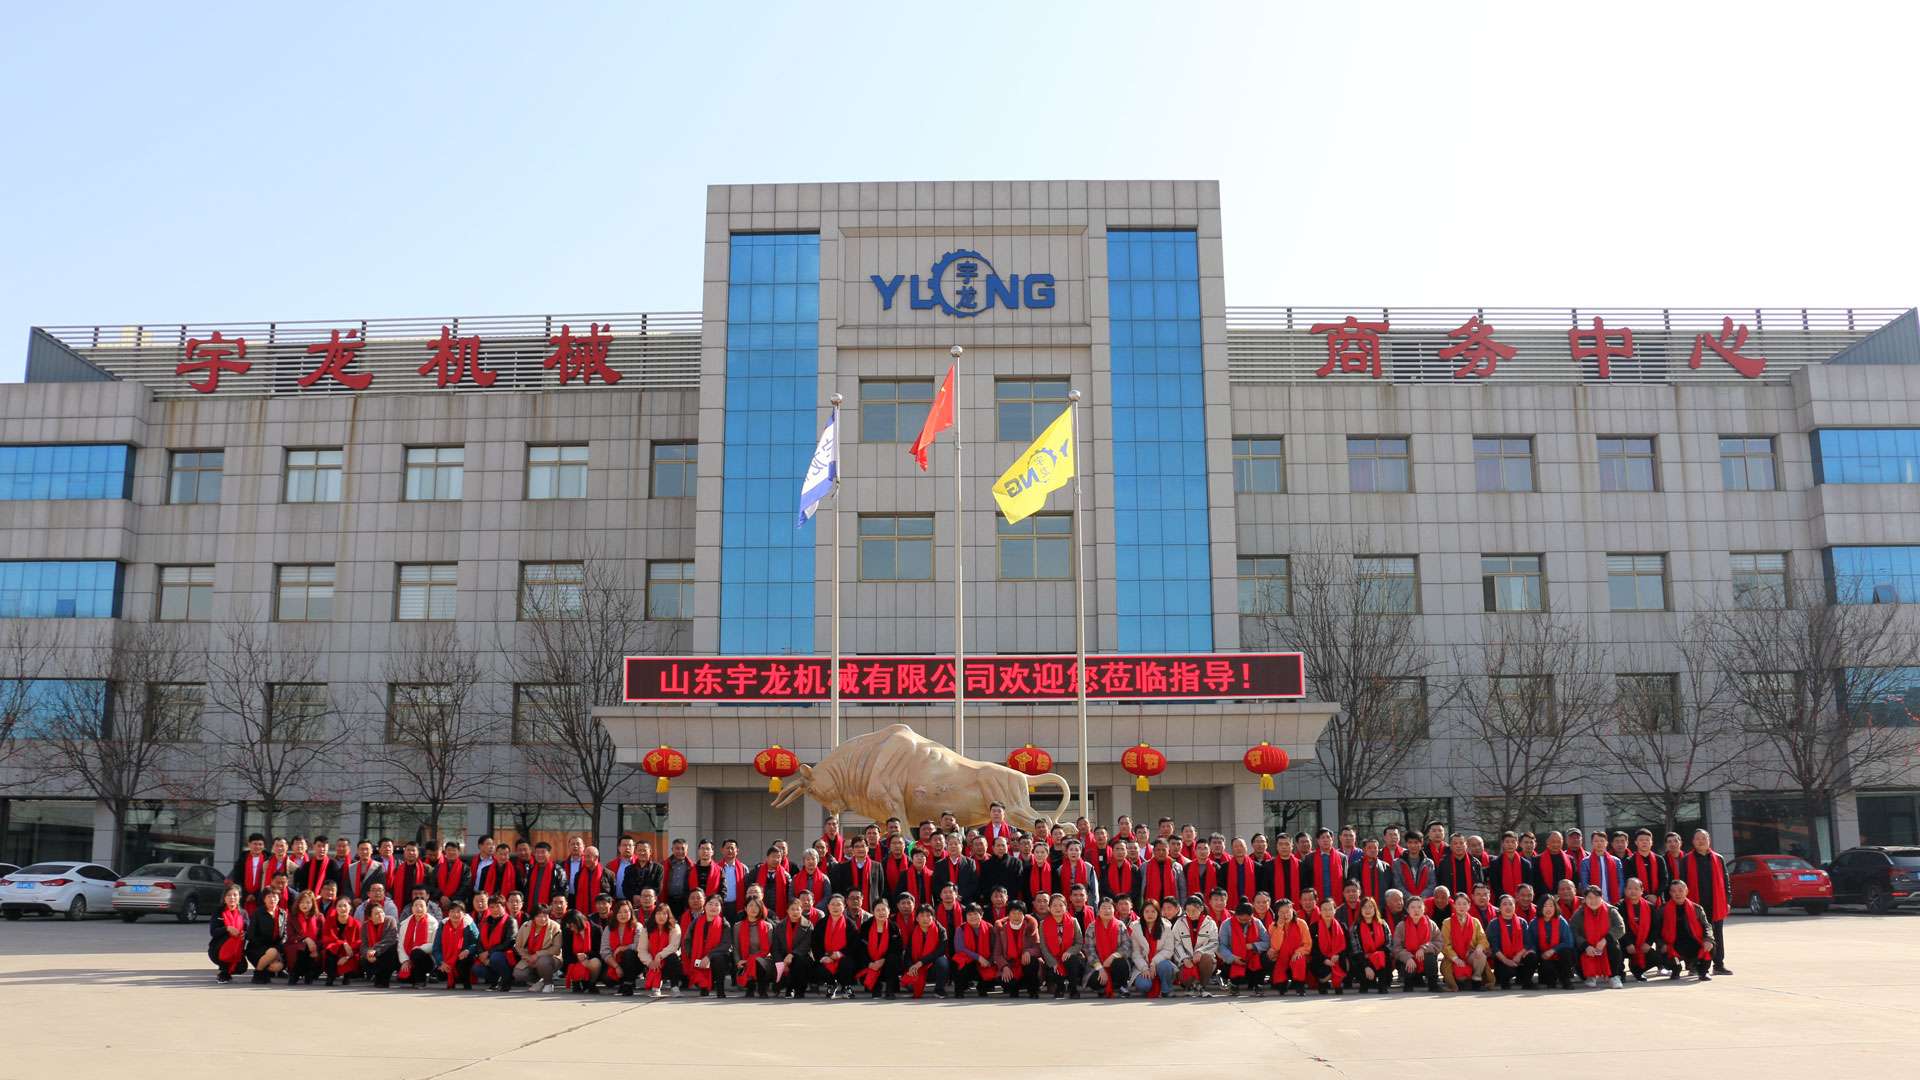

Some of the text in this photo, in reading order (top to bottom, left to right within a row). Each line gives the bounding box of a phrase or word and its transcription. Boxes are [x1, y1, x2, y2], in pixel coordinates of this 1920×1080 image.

[176, 323, 622, 394] 宇龙机械
[1310, 316, 1767, 378] 商务中心
